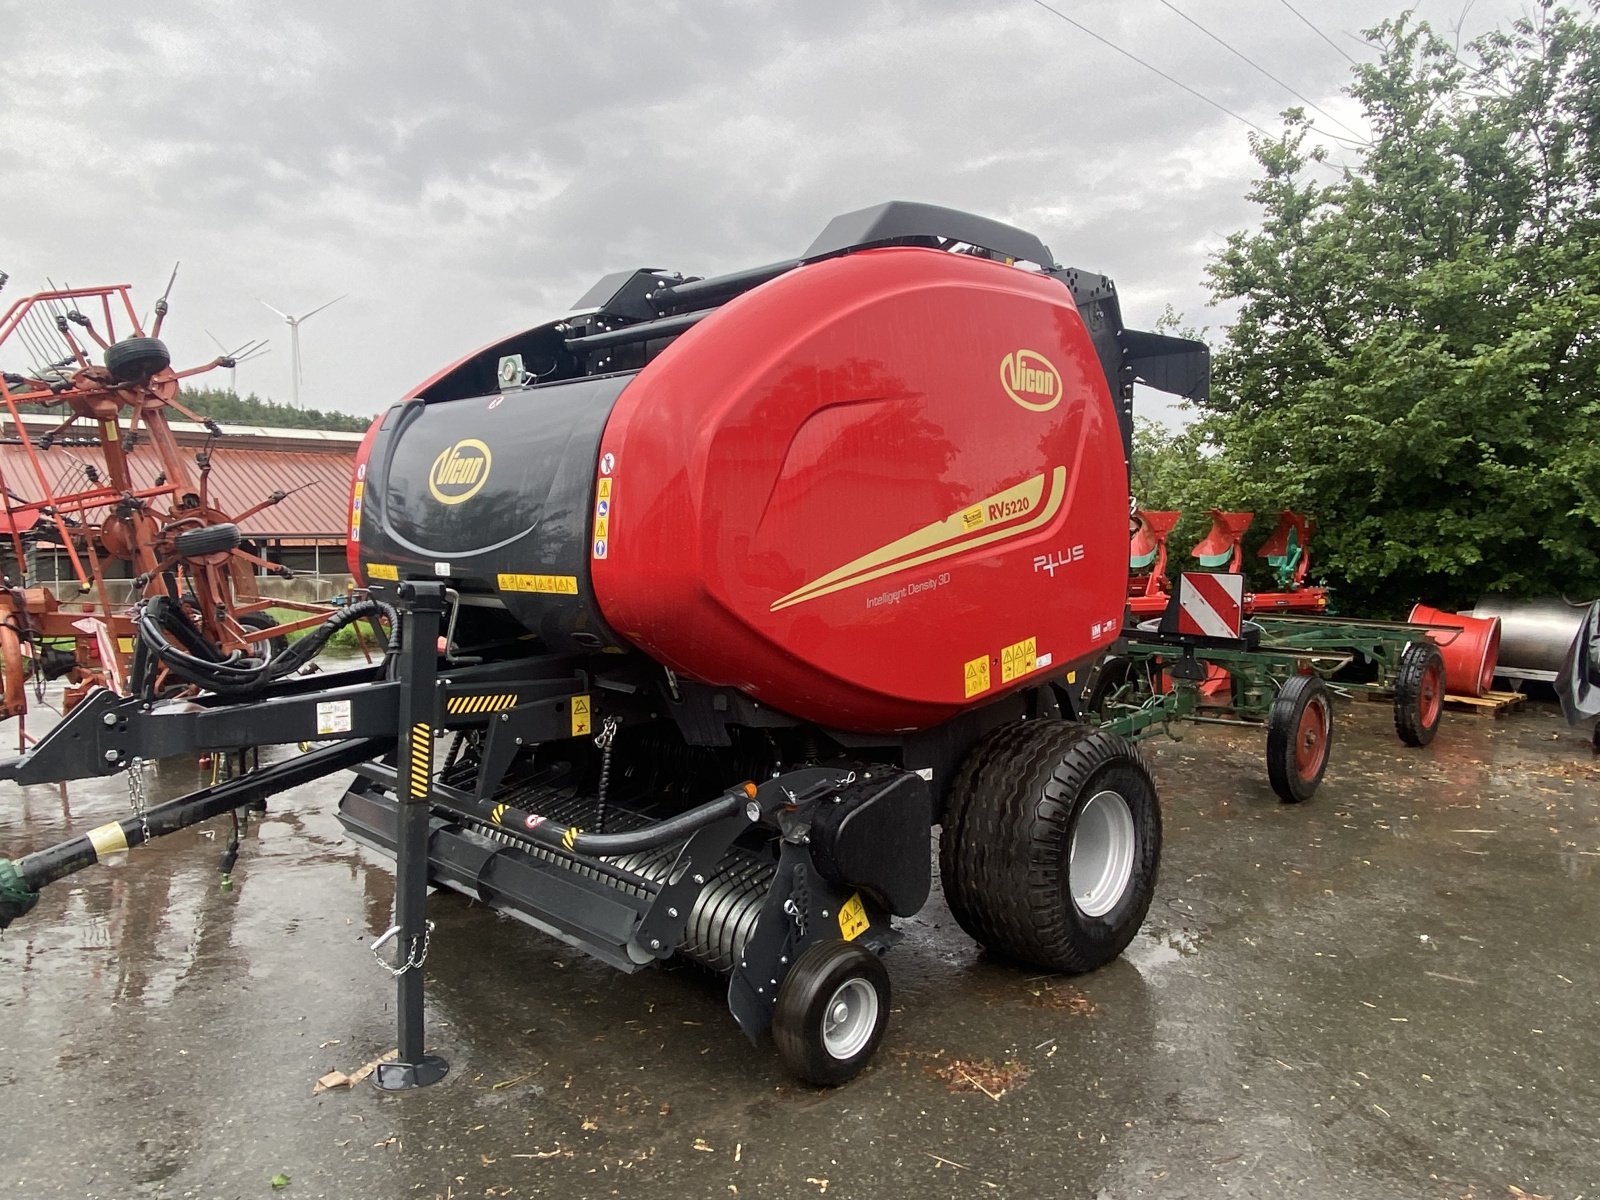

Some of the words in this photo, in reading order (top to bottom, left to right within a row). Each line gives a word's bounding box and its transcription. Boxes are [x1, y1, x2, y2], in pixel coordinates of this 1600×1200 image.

[1009, 351, 1054, 396] Vicon
[435, 446, 484, 485] Vicon
[988, 496, 1030, 521] RV5220
[866, 588, 907, 609] Intelligent
[908, 578, 938, 596] Density
[938, 572, 951, 586] 3D
